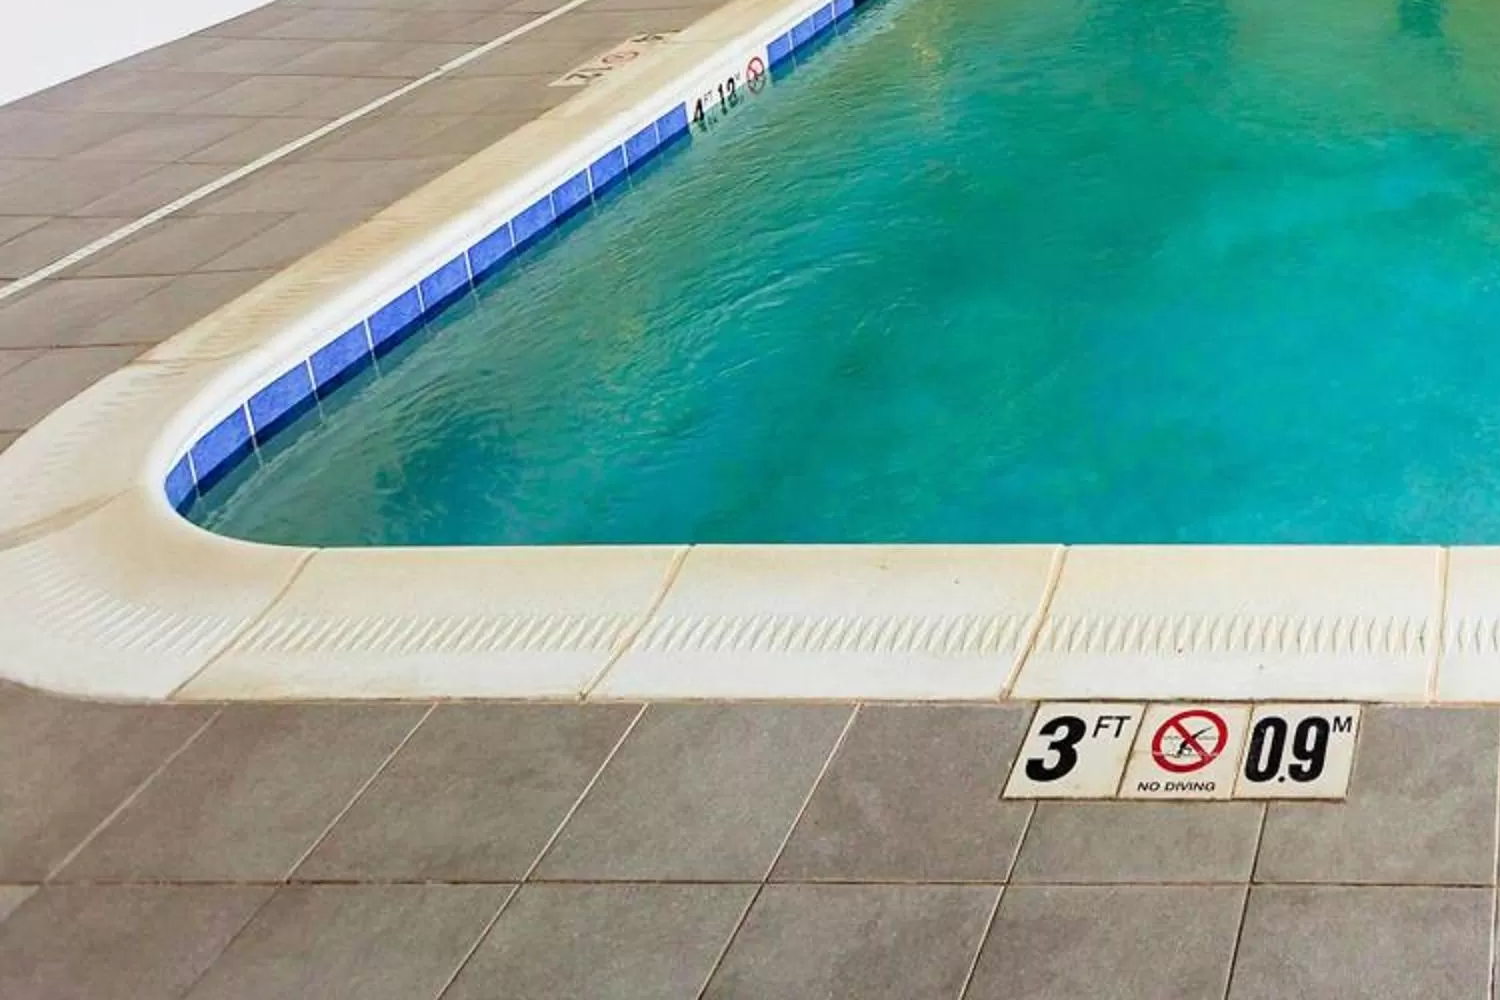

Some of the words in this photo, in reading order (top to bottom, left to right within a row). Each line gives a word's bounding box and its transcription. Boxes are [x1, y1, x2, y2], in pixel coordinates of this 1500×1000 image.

[1332, 715, 1352, 733] M
[1025, 715, 1087, 783] 3
[1092, 715, 1132, 739] FT
[1137, 782, 1161, 793] NO
[1164, 781, 1216, 793] DIVING
